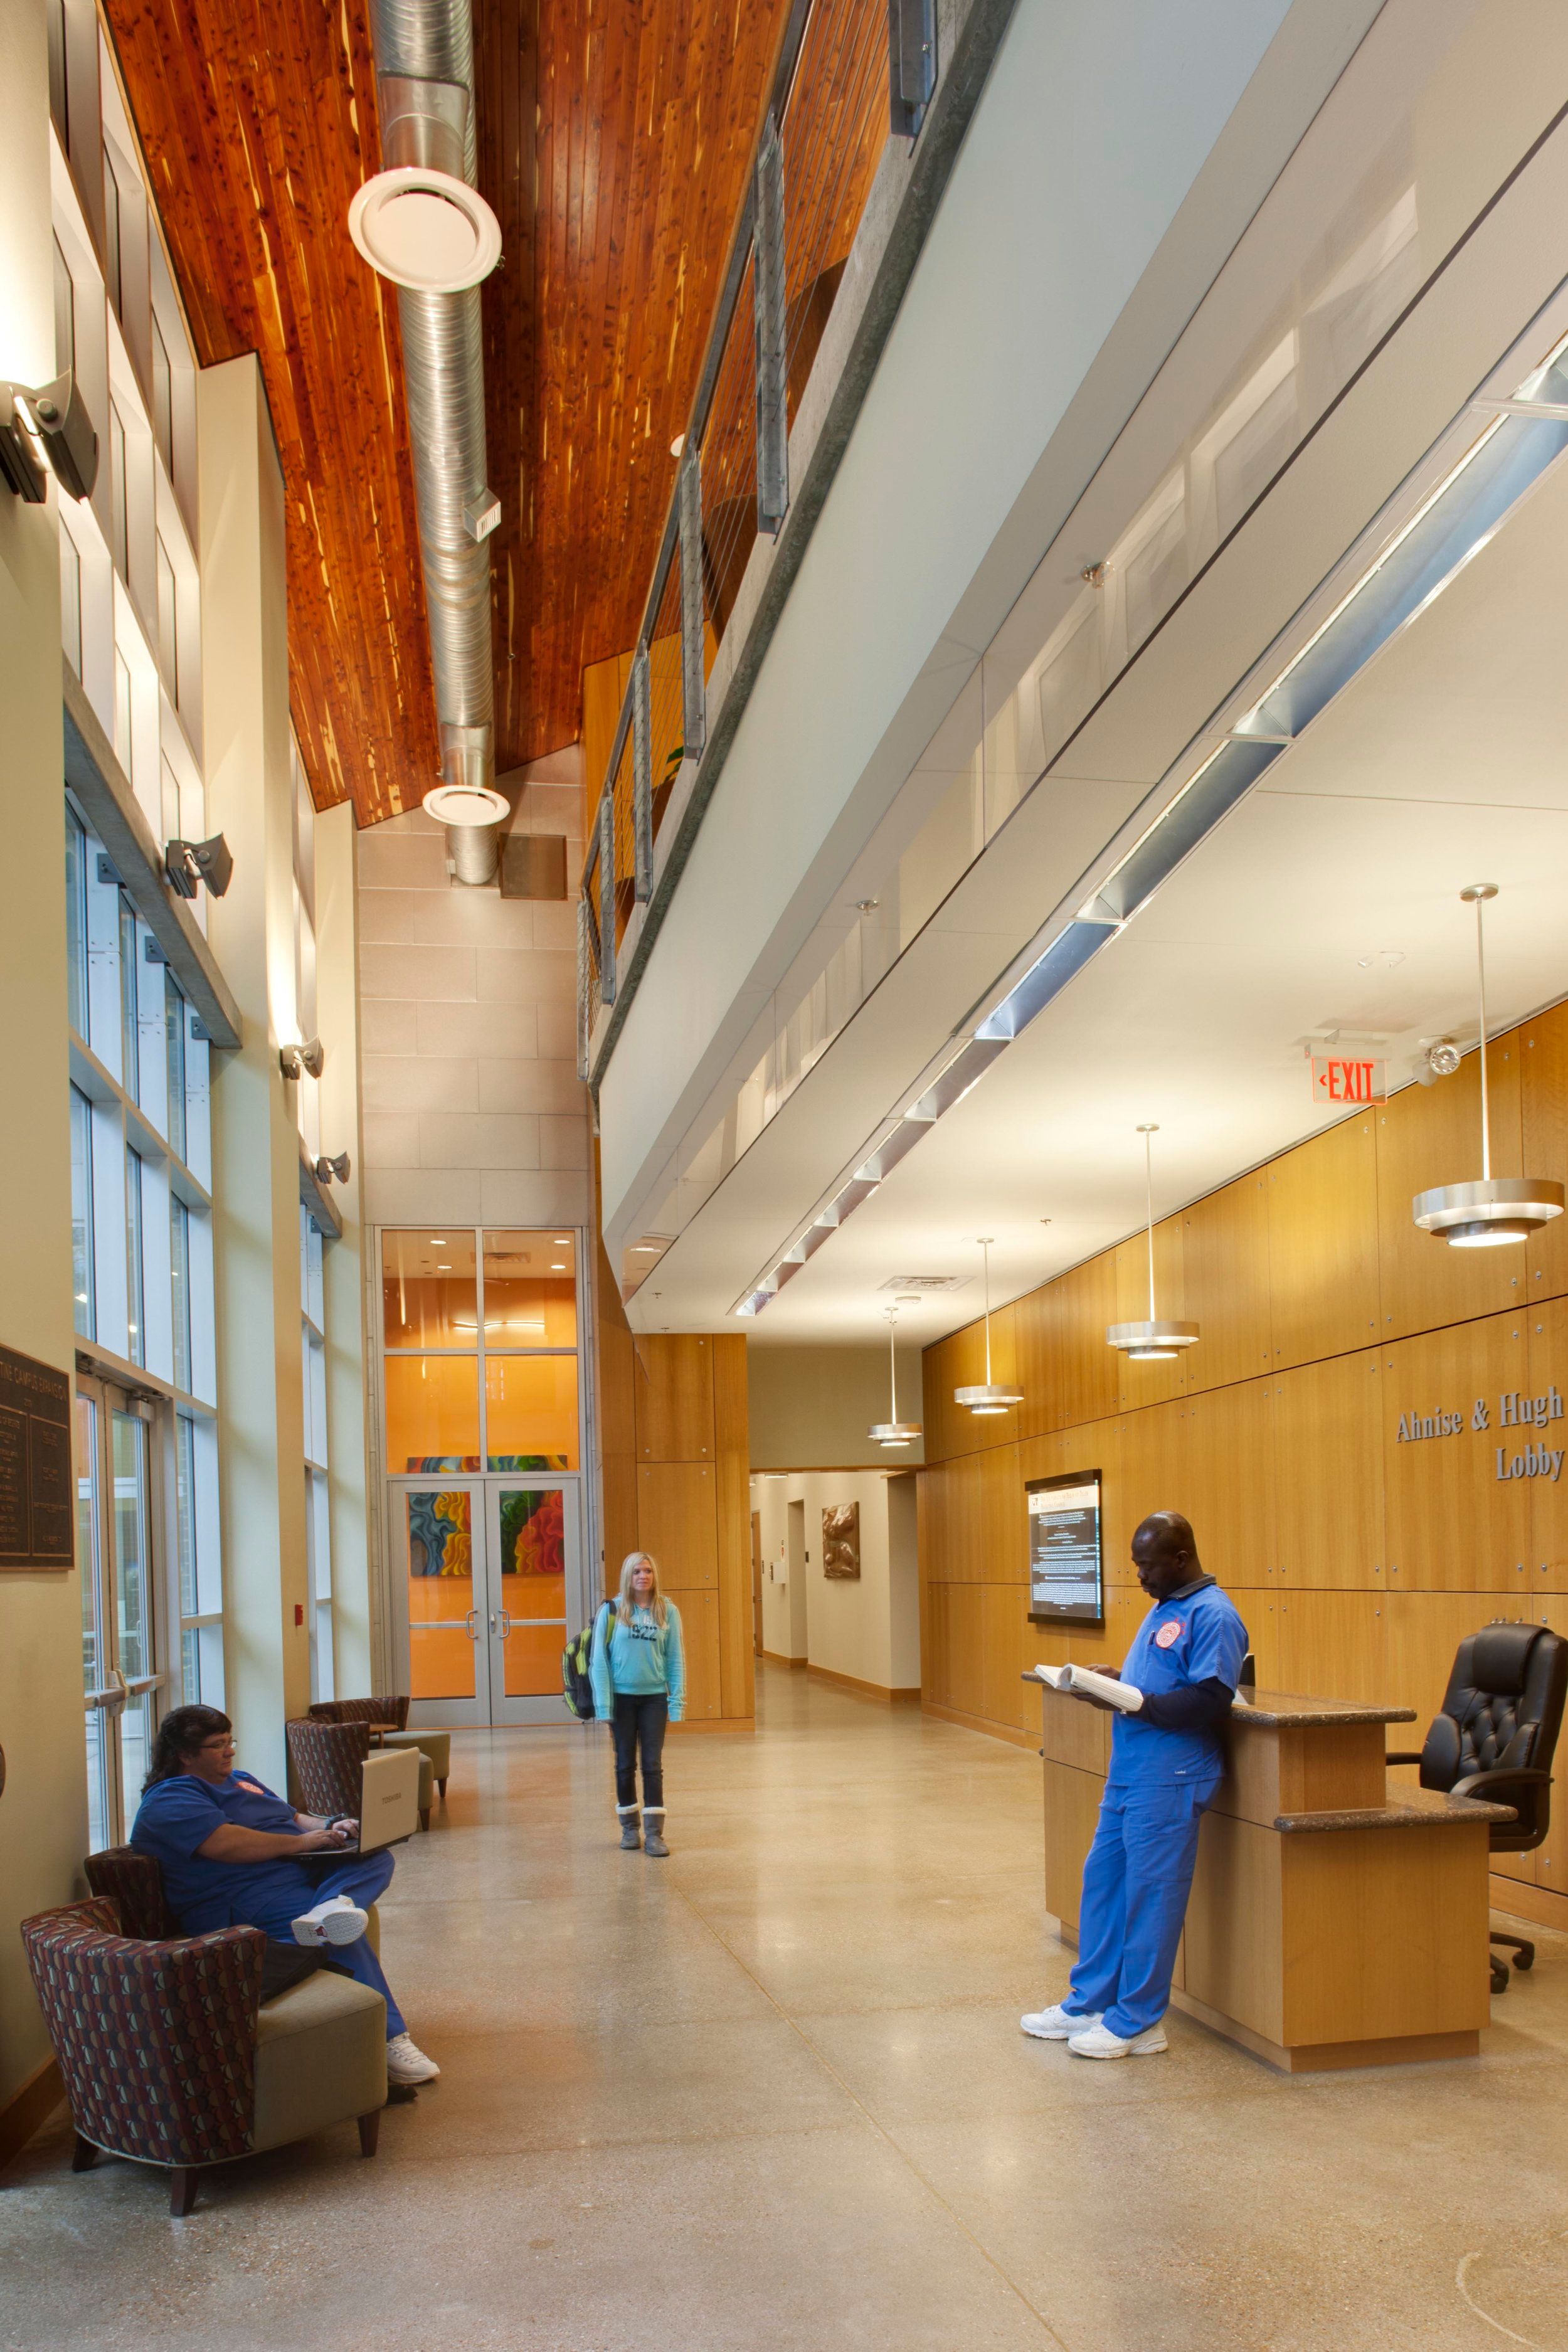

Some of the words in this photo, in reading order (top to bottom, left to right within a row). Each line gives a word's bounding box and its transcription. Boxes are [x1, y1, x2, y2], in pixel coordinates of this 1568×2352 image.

[1328, 1061, 1374, 1101] EXIT
[14, 1367, 38, 1391] CAMPUS
[1396, 1406, 1463, 1443] Ahnise
[1471, 1399, 1490, 1431] &
[1499, 1385, 1564, 1428] Hugh
[1495, 1443, 1565, 1481] Lobby
[381, 1792, 402, 1805] TOSHIBA
